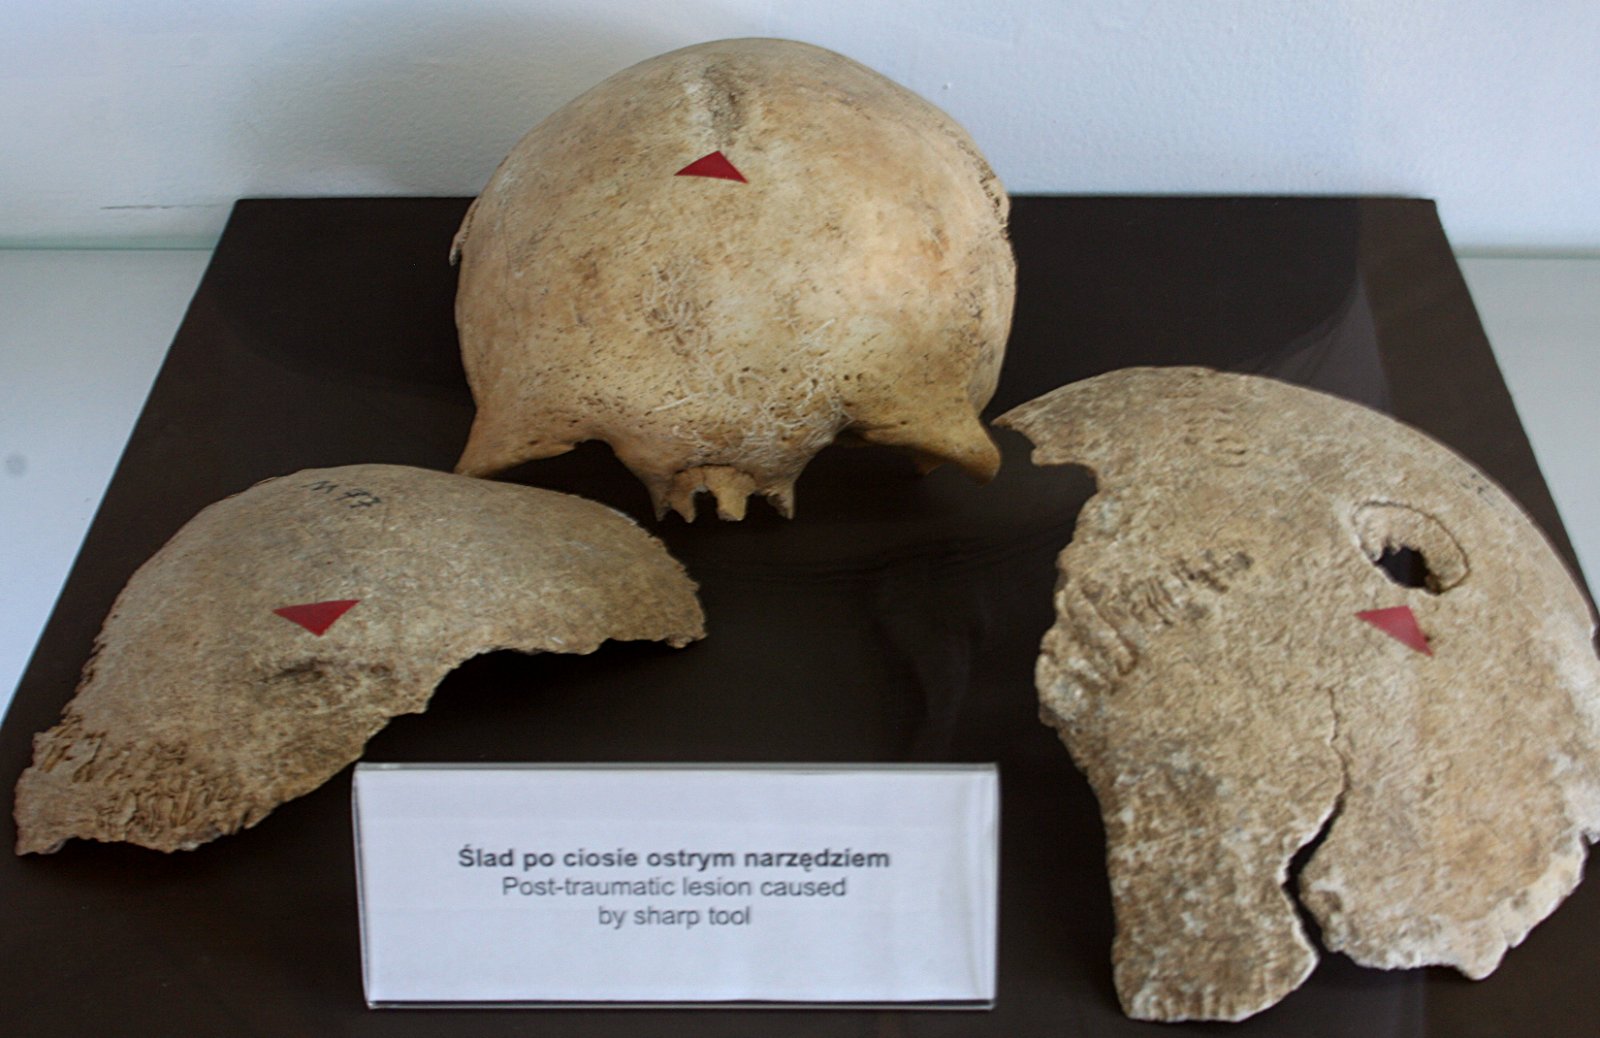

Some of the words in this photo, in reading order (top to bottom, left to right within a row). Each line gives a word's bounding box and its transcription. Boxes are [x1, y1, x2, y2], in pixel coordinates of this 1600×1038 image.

[459, 844, 515, 867] Ślad
[523, 852, 555, 871] po
[563, 848, 638, 867] ciosie
[647, 850, 735, 871] ostrym
[744, 848, 890, 871] narzędziem
[502, 877, 675, 896] Post-traumatic
[683, 877, 752, 896] lesion
[760, 877, 847, 896] caused
[599, 907, 626, 929] by
[634, 907, 700, 929] sharp
[708, 907, 750, 925] tool
